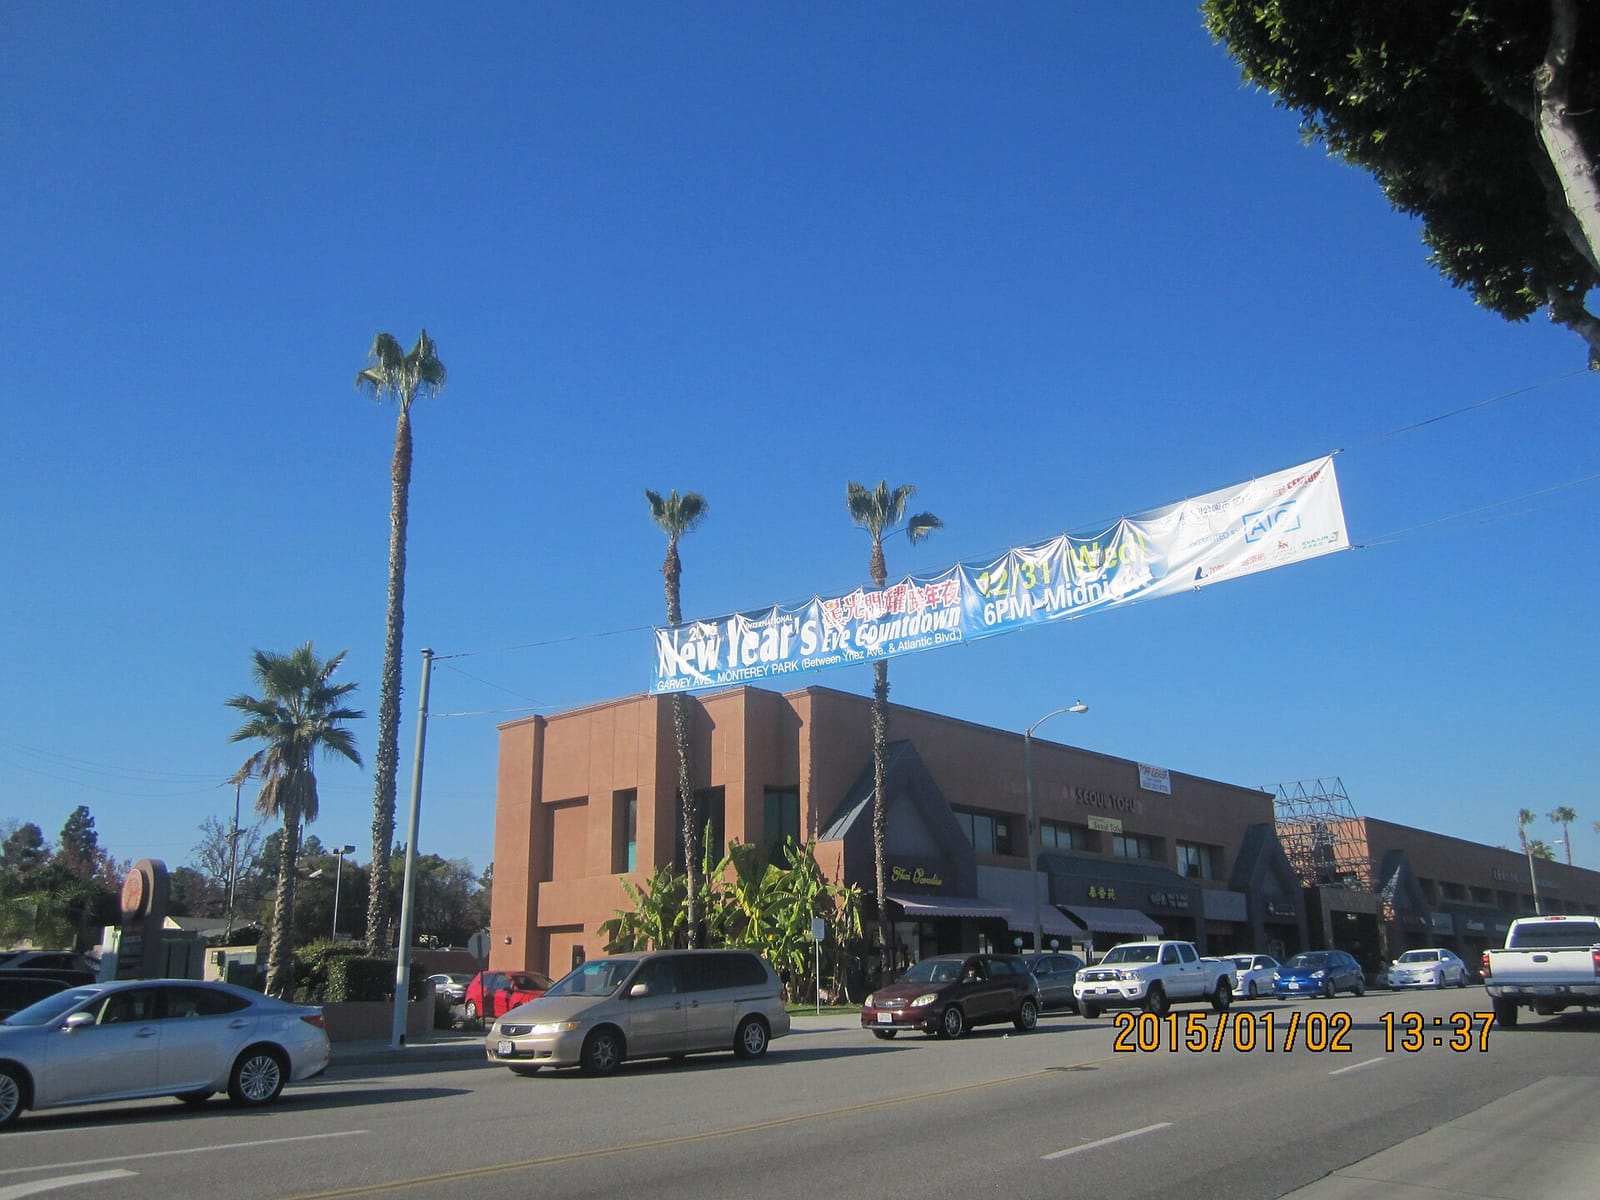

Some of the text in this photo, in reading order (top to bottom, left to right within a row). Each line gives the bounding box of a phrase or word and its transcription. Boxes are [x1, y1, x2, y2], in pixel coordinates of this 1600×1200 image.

[656, 628, 721, 678] New
[821, 626, 850, 653] Eve
[854, 607, 960, 646] Countdown
[657, 677, 692, 692] GARVEY
[717, 665, 770, 683] MONTEREY
[771, 660, 799, 675] PARK
[801, 654, 841, 671] (Between
[866, 646, 887, 658] Ave.
[888, 643, 896, 653] &
[897, 636, 933, 652] Atlantic
[1075, 788, 1137, 814] SEOUL TOFU
